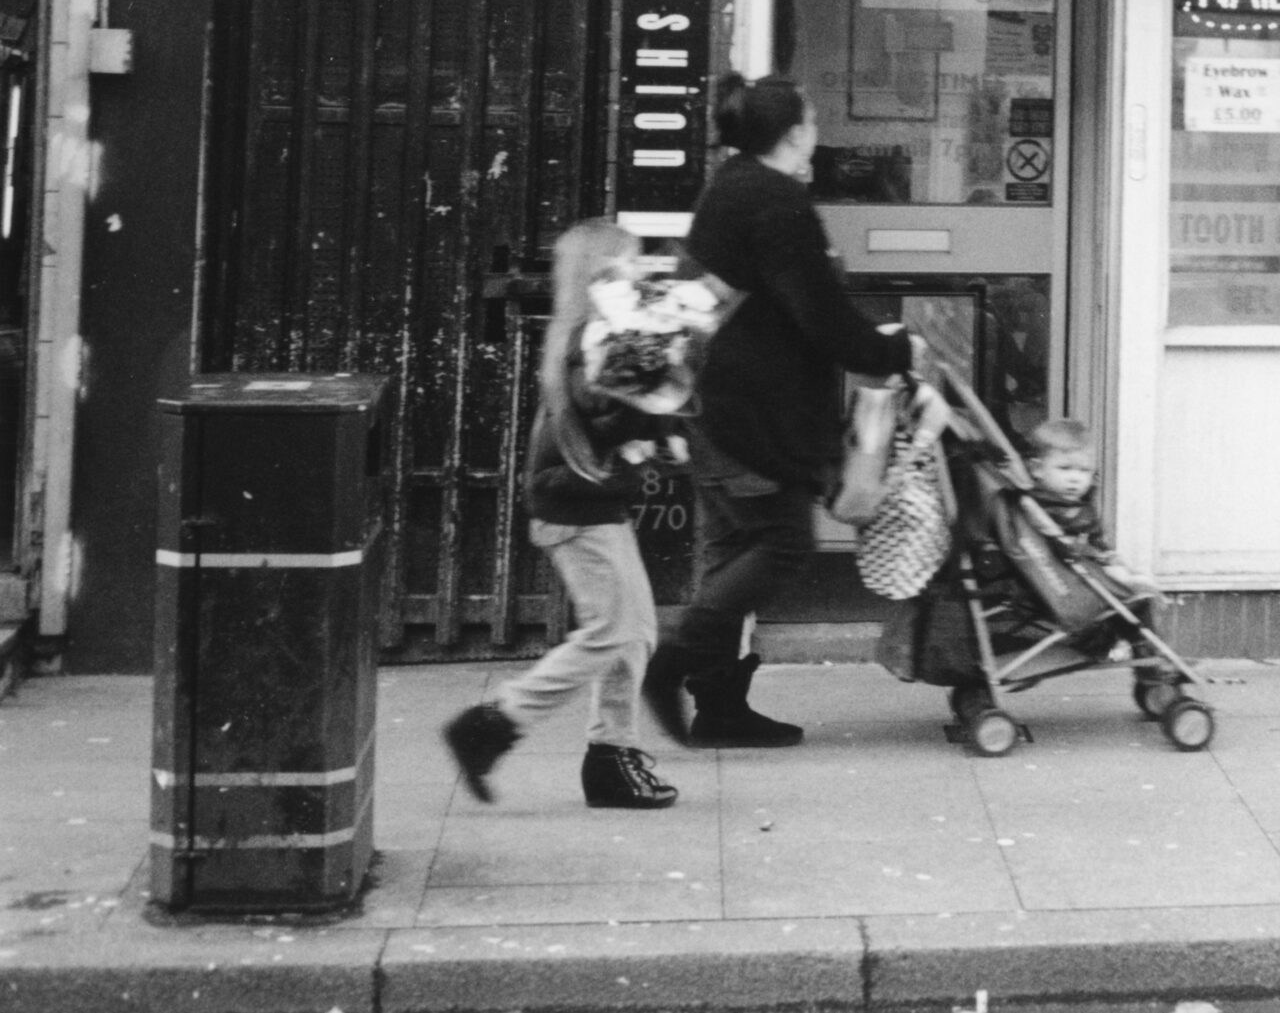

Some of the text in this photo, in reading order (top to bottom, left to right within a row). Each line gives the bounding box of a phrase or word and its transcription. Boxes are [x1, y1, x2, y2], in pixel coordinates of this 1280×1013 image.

[1203, 65, 1269, 79] Eyebrow
[1219, 85, 1252, 99] Wax
[1213, 108, 1263, 124] £5.00
[1180, 213, 1265, 245] TOOTH
[631, 504, 687, 531] 770
